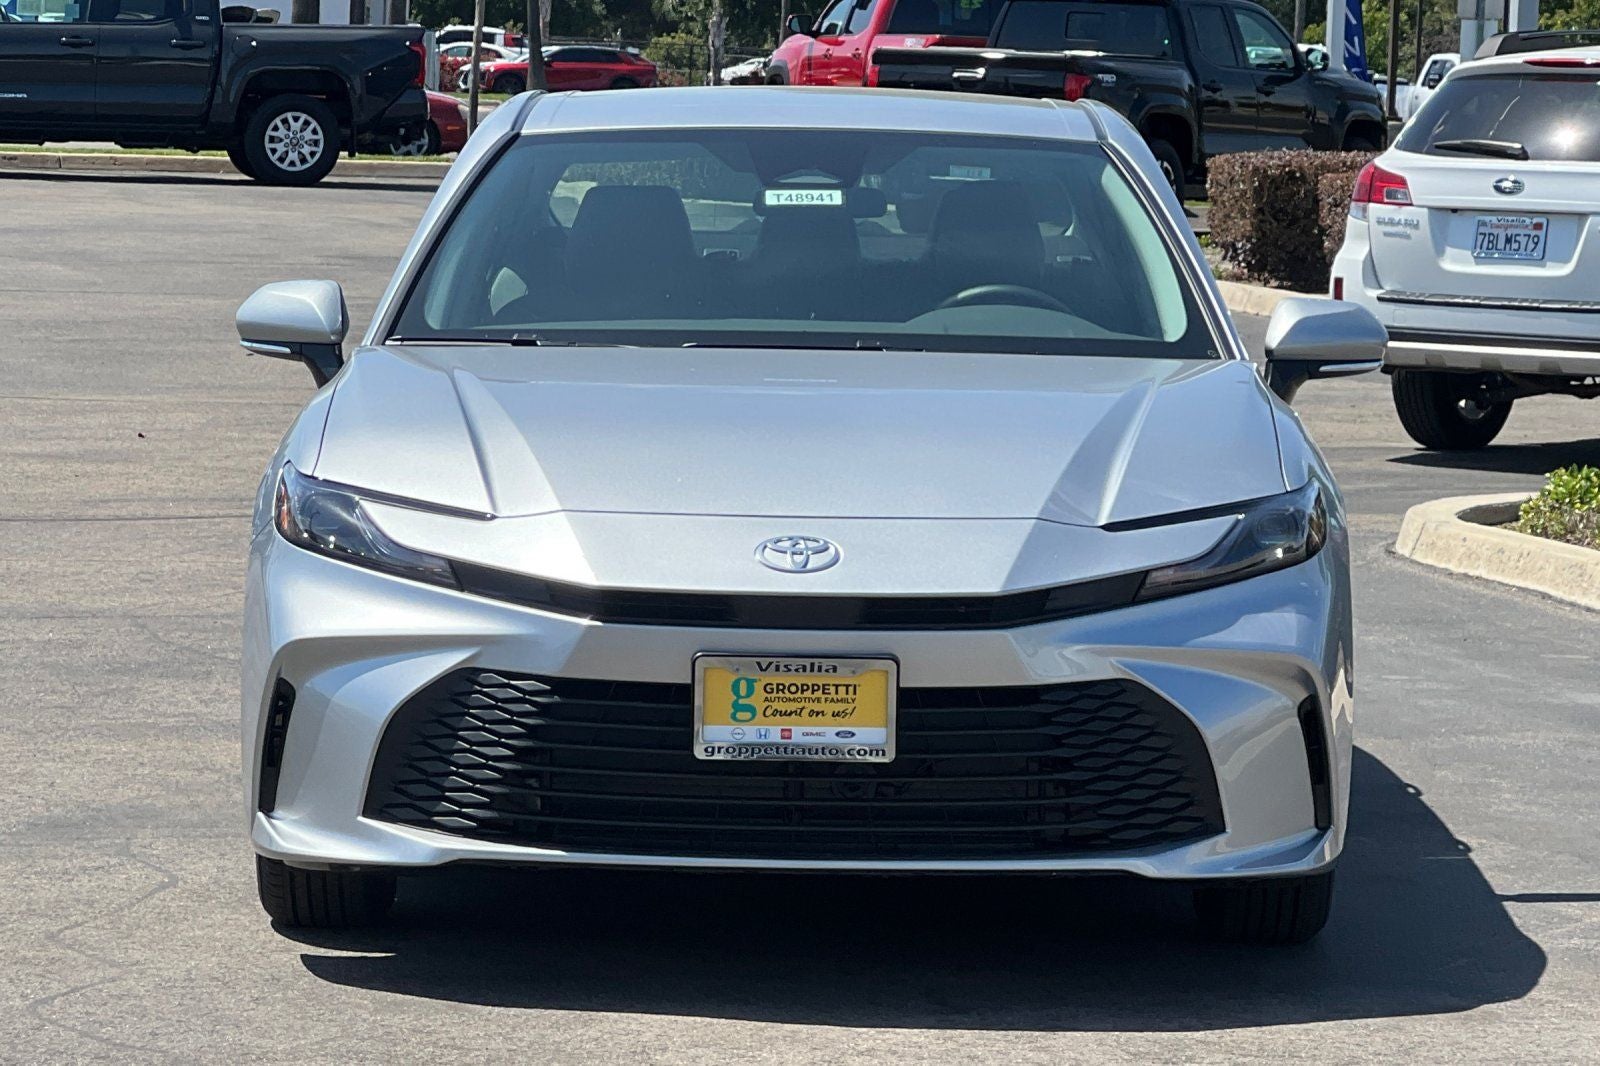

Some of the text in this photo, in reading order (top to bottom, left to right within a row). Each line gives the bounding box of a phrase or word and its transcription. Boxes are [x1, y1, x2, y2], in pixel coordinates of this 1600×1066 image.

[772, 192, 834, 203] T48941
[1478, 232, 1541, 253] 7BLM579
[755, 660, 838, 674] Visalia
[763, 682, 857, 695] GROPPETTI
[763, 696, 857, 705] AUTOMOTIVE FAMILY
[762, 704, 857, 719] Count on us!
[703, 743, 887, 758] groppettiauto.com
